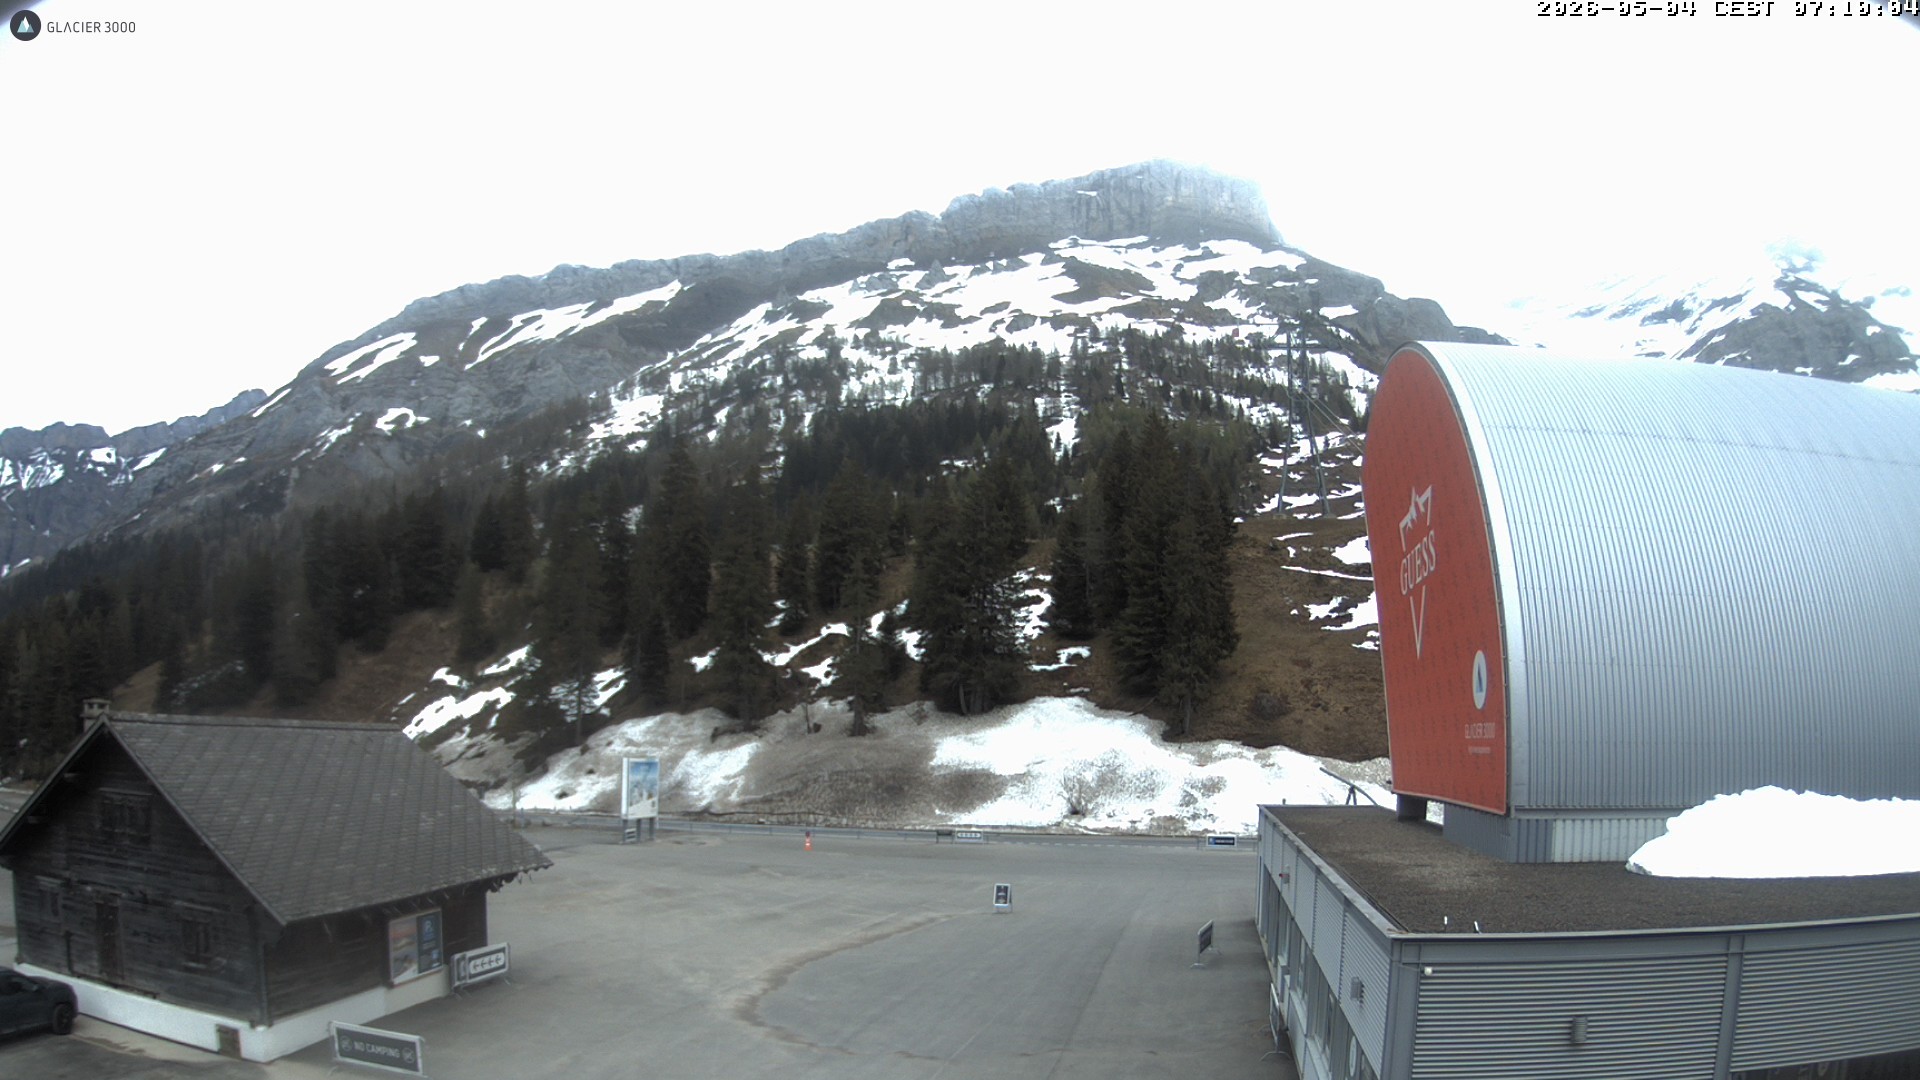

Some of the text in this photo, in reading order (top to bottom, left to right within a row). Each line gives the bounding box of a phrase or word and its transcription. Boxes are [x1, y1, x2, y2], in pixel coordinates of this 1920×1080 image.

[1400, 529, 1437, 597] GUESS
[353, 1041, 401, 1058] NO CAMPING
